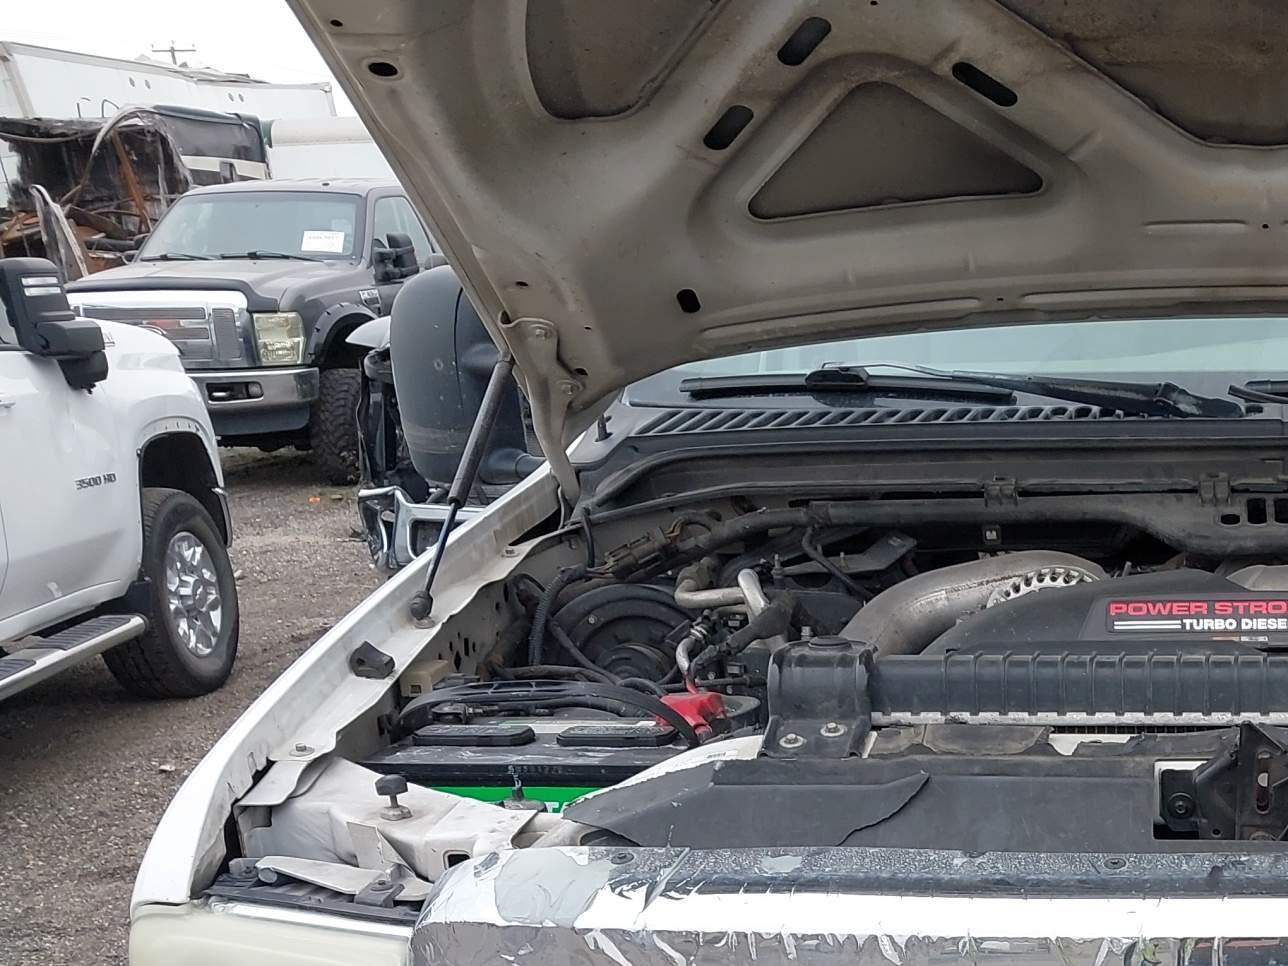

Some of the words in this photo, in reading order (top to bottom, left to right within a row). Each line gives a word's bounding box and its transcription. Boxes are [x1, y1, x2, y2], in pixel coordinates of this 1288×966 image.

[75, 476, 102, 490] 3500
[1109, 602, 1209, 616] POWER
[1182, 618, 1237, 631] TURBO
